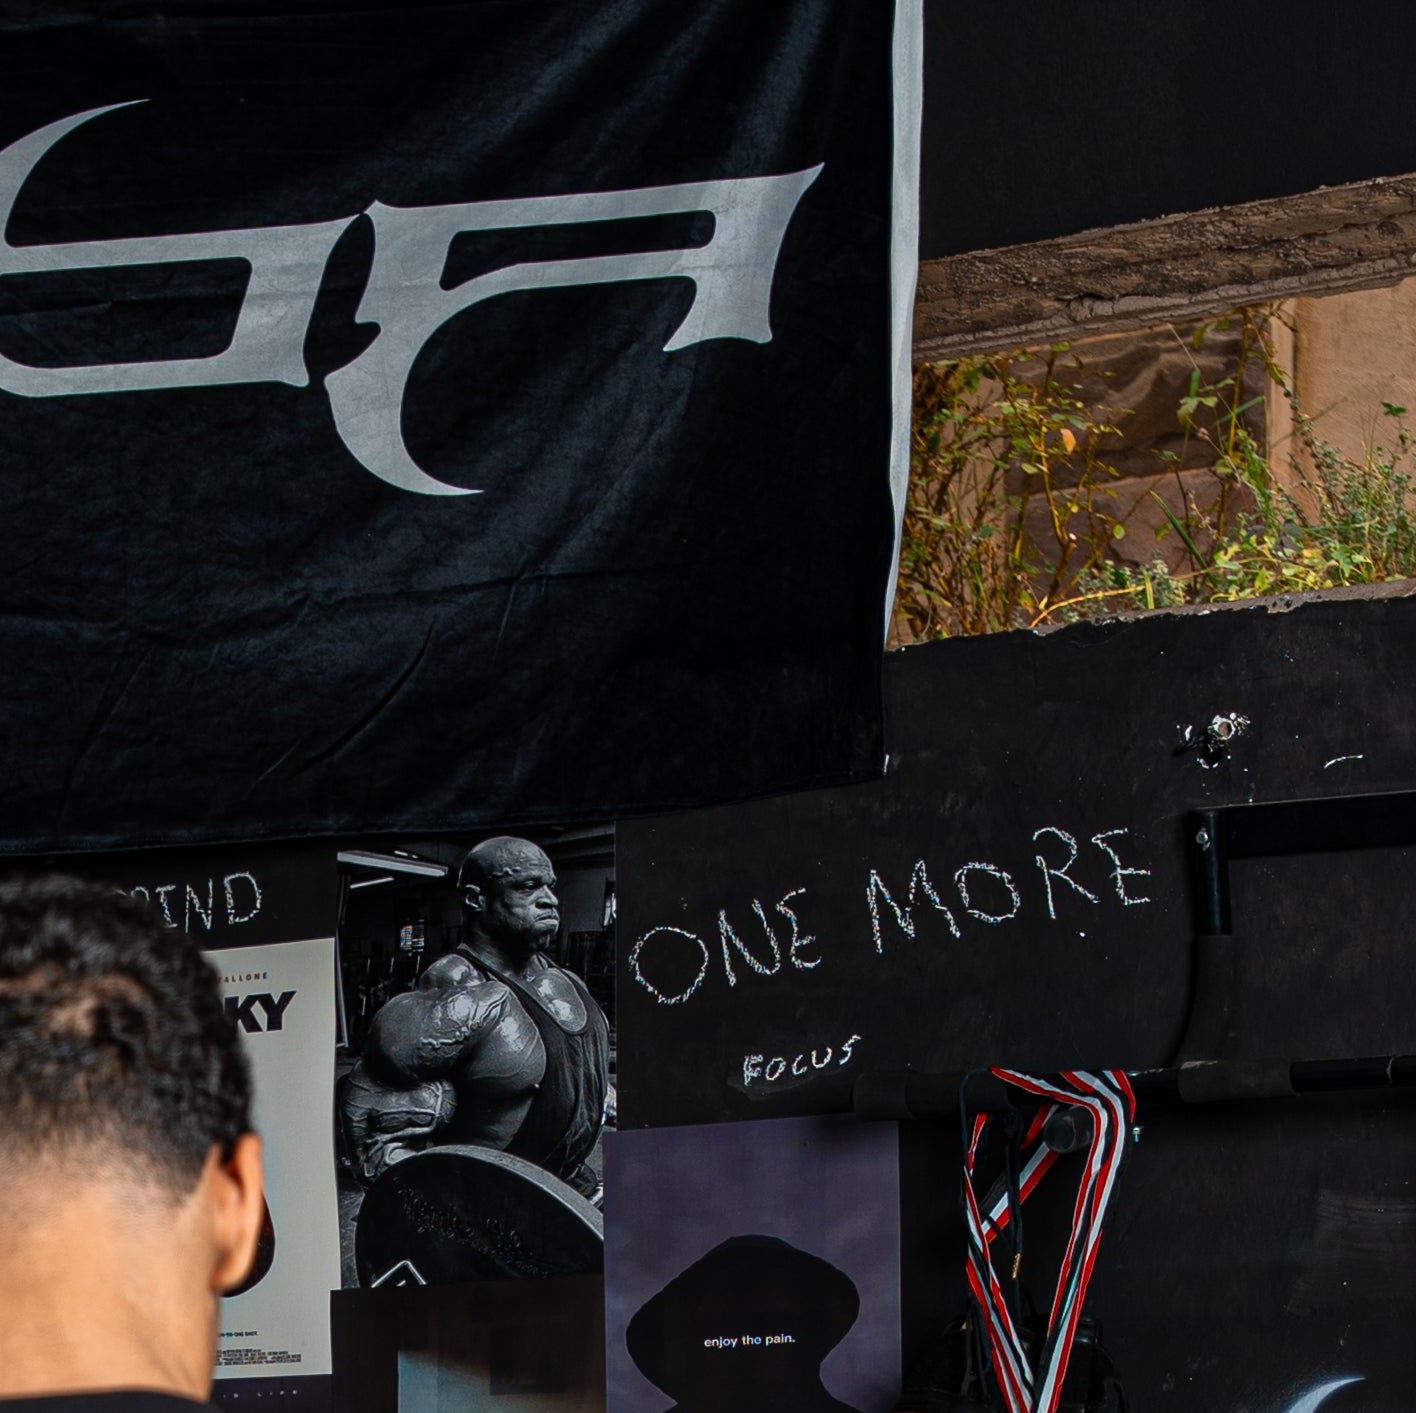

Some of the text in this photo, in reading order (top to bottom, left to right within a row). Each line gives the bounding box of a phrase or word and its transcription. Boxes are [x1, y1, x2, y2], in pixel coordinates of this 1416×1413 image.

[628, 826, 1152, 1005] ONE MORE
[743, 1034, 862, 1087] FOCUS
[703, 1332, 797, 1349] enjoy the pain.
